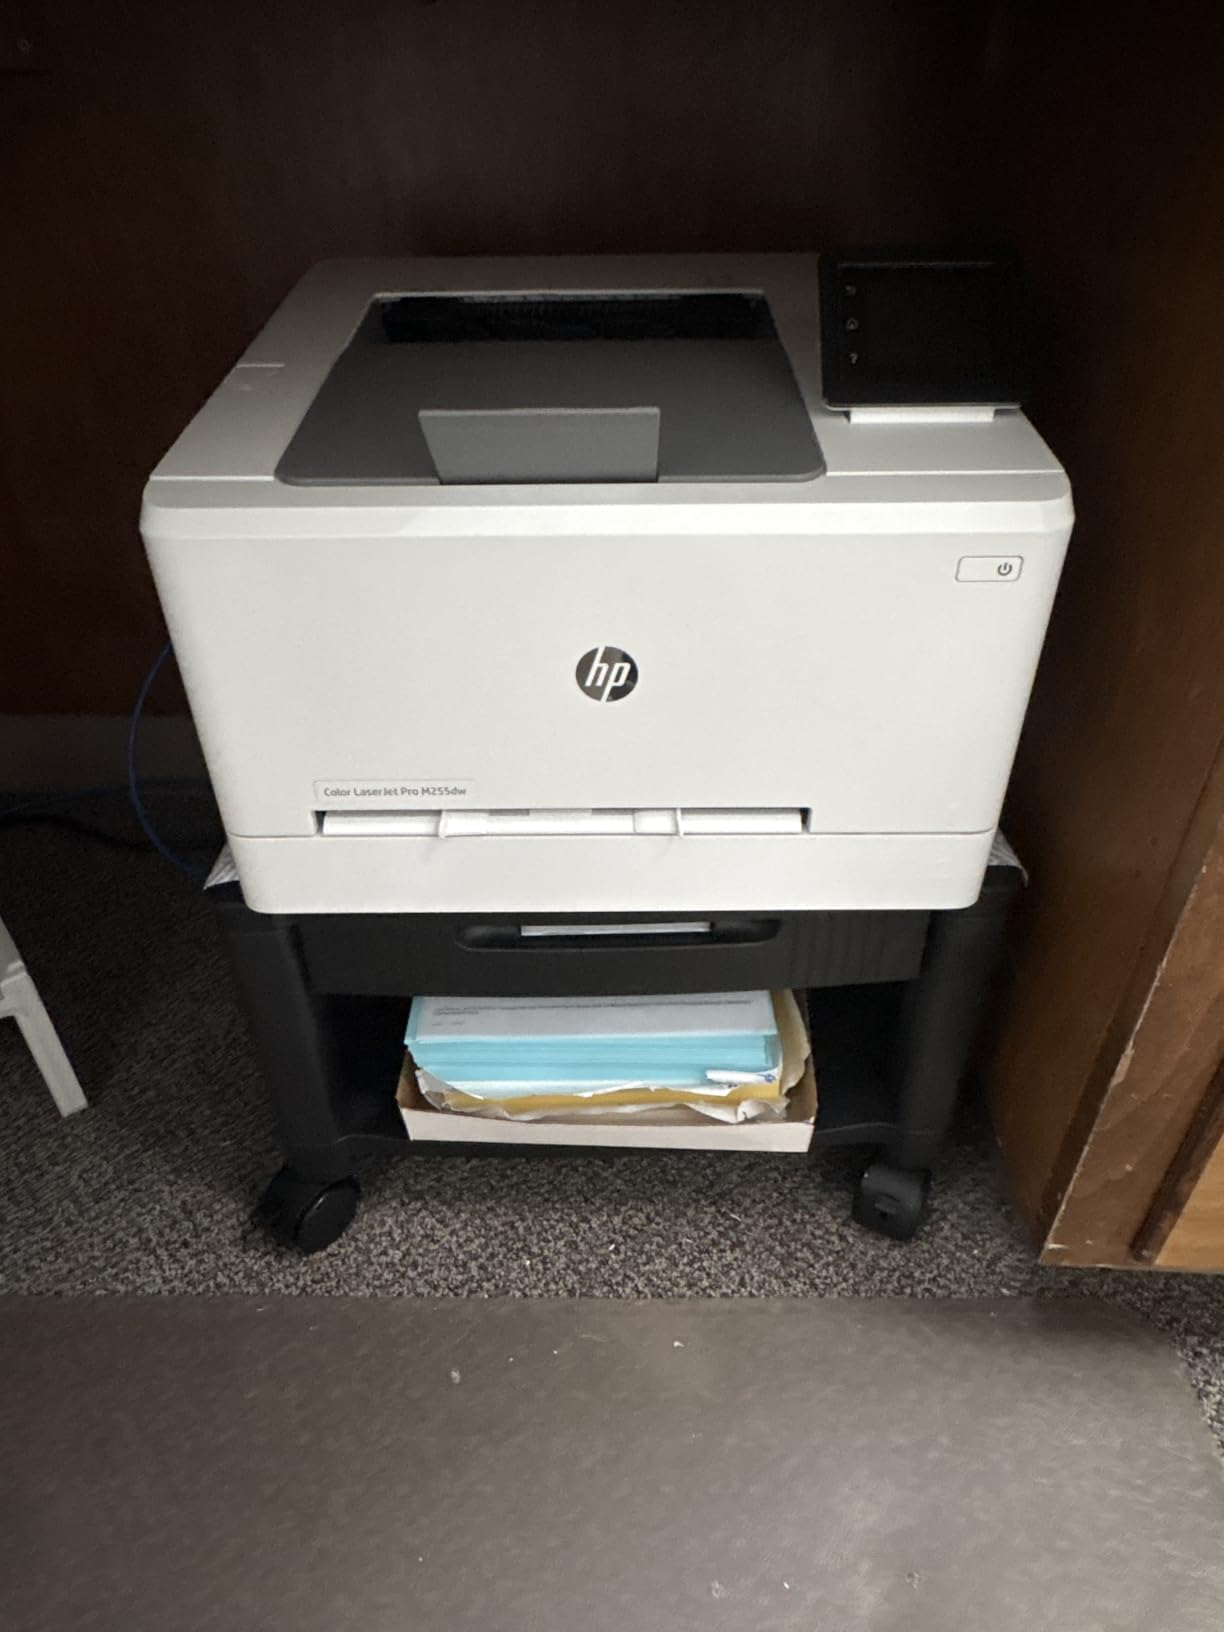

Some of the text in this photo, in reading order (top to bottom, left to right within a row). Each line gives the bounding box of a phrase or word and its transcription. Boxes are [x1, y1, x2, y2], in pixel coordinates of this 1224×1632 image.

[583, 645, 632, 702] hp
[323, 785, 467, 797] Color LaserJet Pro M255dw
